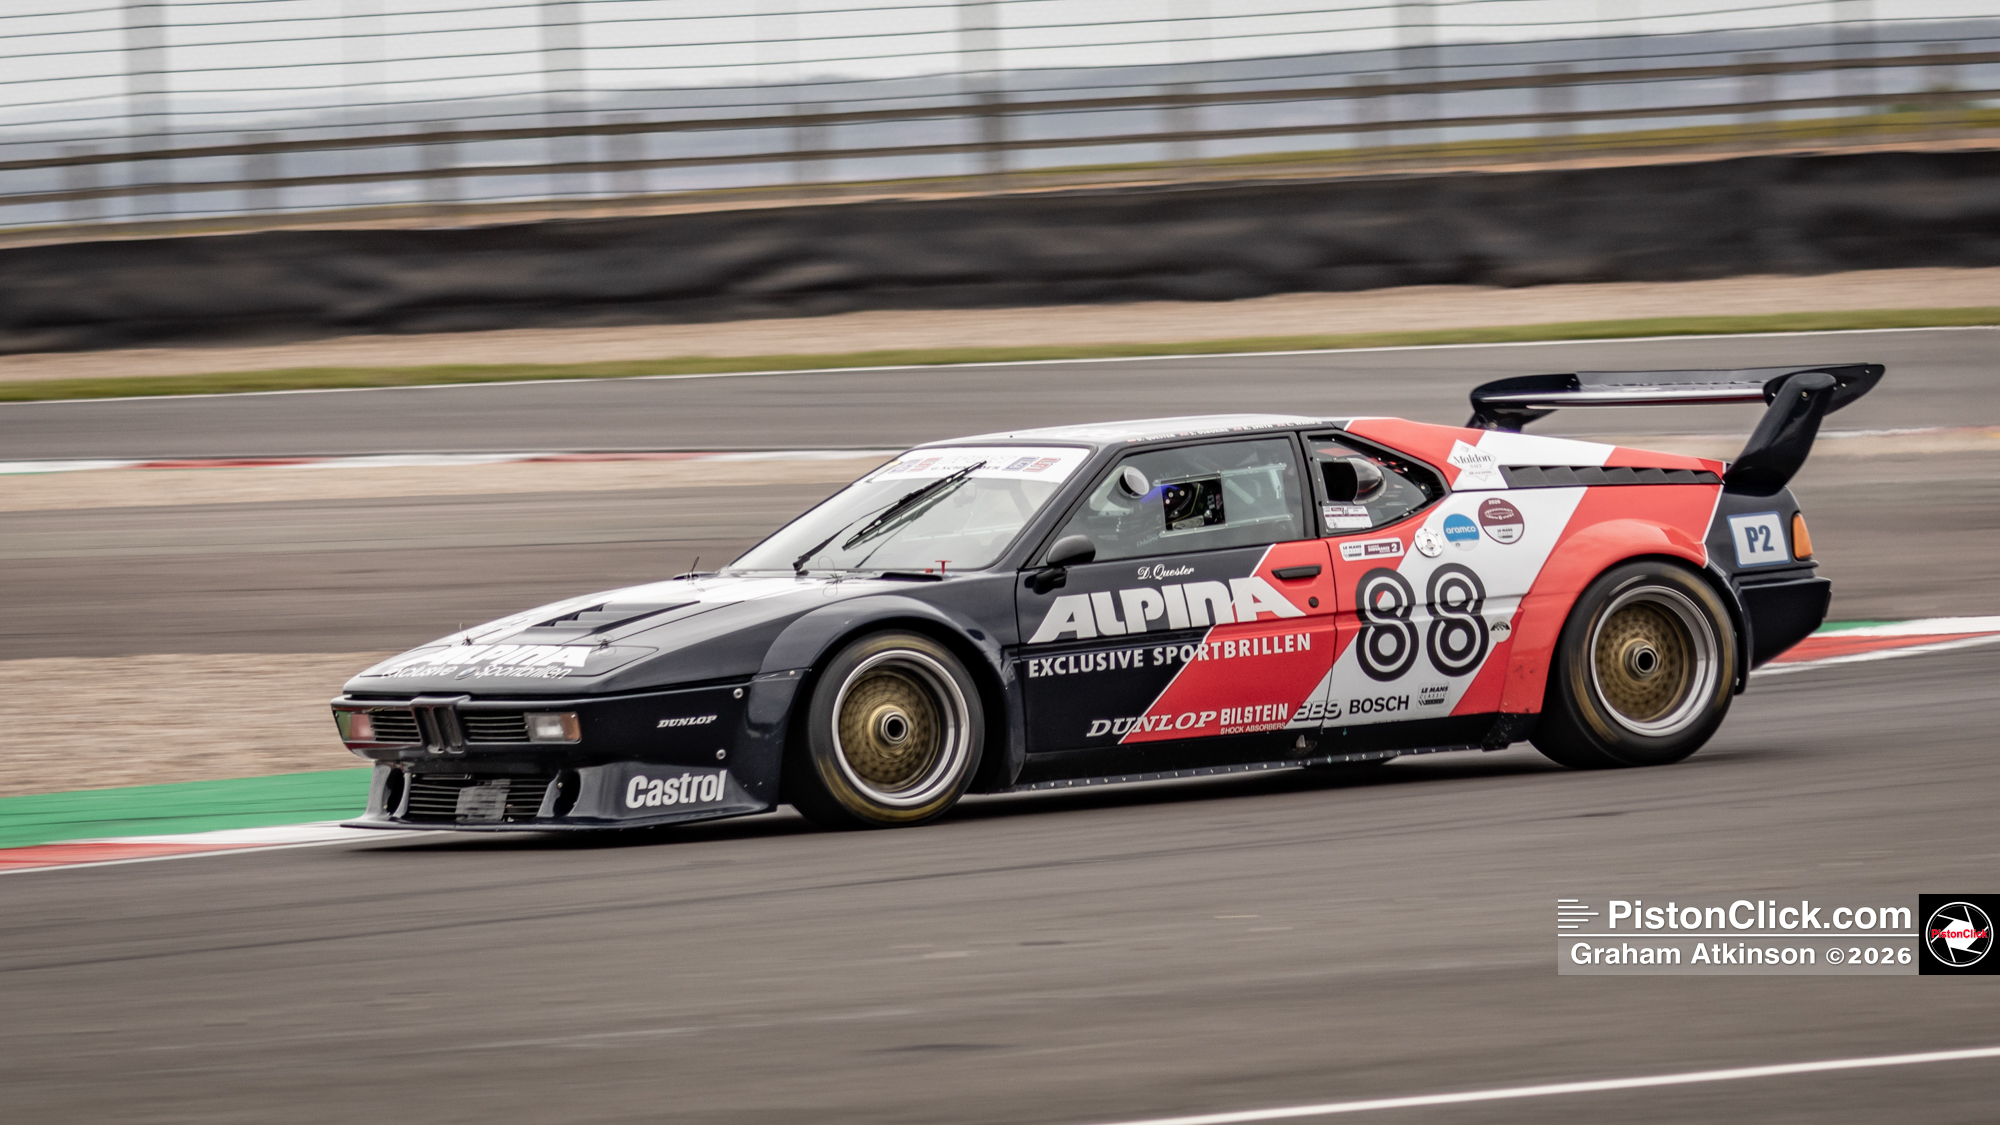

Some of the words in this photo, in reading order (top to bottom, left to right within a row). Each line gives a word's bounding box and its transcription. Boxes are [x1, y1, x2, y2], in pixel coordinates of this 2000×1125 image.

[1446, 525, 1477, 534] aramco
[1744, 524, 1775, 554] P2
[1391, 543, 1398, 552] 2
[1027, 575, 1307, 644] ALPINA
[1355, 562, 1490, 682] 88
[1028, 649, 1144, 678] EXCLUSIVE
[1153, 632, 1311, 666] SPORTBRILLEN
[1429, 685, 1449, 693] MANS
[1220, 703, 1289, 725] BILSTEIN
[1349, 695, 1410, 715] BOSCH
[656, 715, 718, 729] DUNLOP
[1086, 710, 1218, 737] DUNLOP
[1220, 725, 1244, 735] SHOCK
[1245, 722, 1286, 733] ABSORBERS
[626, 769, 728, 809] Castrol
